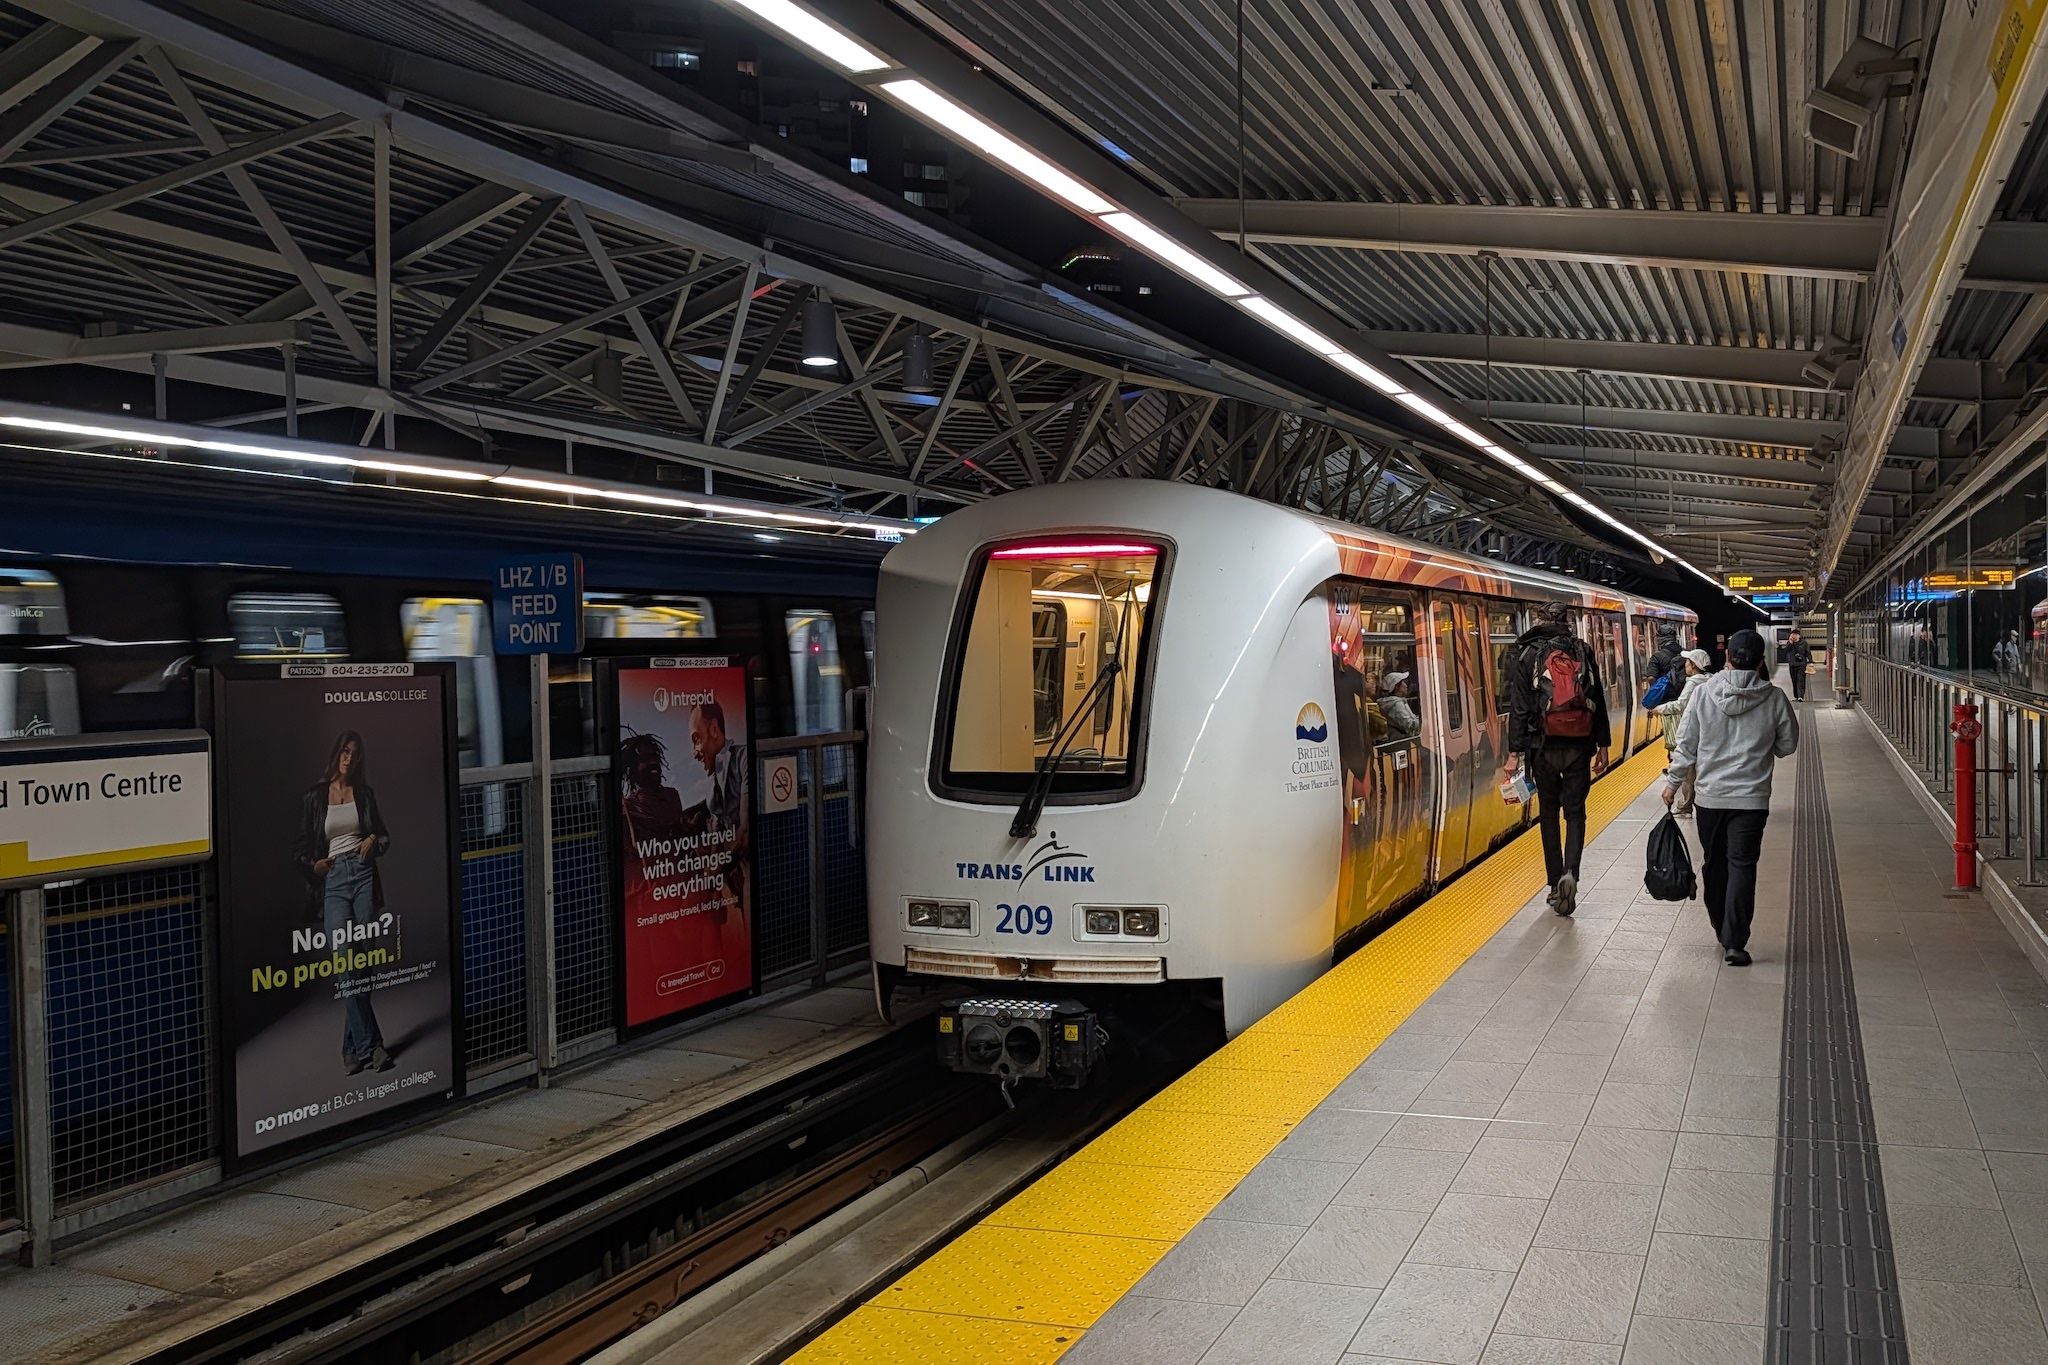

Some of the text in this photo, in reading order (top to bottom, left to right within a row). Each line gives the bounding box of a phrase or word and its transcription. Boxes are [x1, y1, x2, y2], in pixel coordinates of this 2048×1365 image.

[500, 564, 567, 589] LHZ I/B
[7, 607, 44, 617] slink.ca
[512, 594, 557, 615] FEED
[510, 621, 561, 644] POINT
[289, 665, 409, 675] PATTISON 604-235-2700
[671, 688, 714, 707] Intrepid
[33, 727, 55, 736] LINK
[18, 779, 90, 806] Town
[100, 771, 182, 799] Centre
[636, 823, 736, 859] Who you travel
[642, 850, 732, 880] with changes
[956, 863, 1095, 882] TRANS LINK
[652, 872, 724, 901] everything
[637, 912, 658, 927] Small
[658, 909, 680, 924] group
[701, 900, 712, 911] led
[712, 899, 720, 910] by
[995, 904, 1053, 935] 209
[292, 927, 327, 954] No
[332, 912, 394, 951] plan?
[252, 947, 395, 993] No problem.
[277, 1103, 320, 1127] more
[320, 1101, 331, 1113] at
[333, 1090, 364, 1109] B.C.'s
[366, 1079, 399, 1100] largest
[400, 1069, 437, 1089] college.
